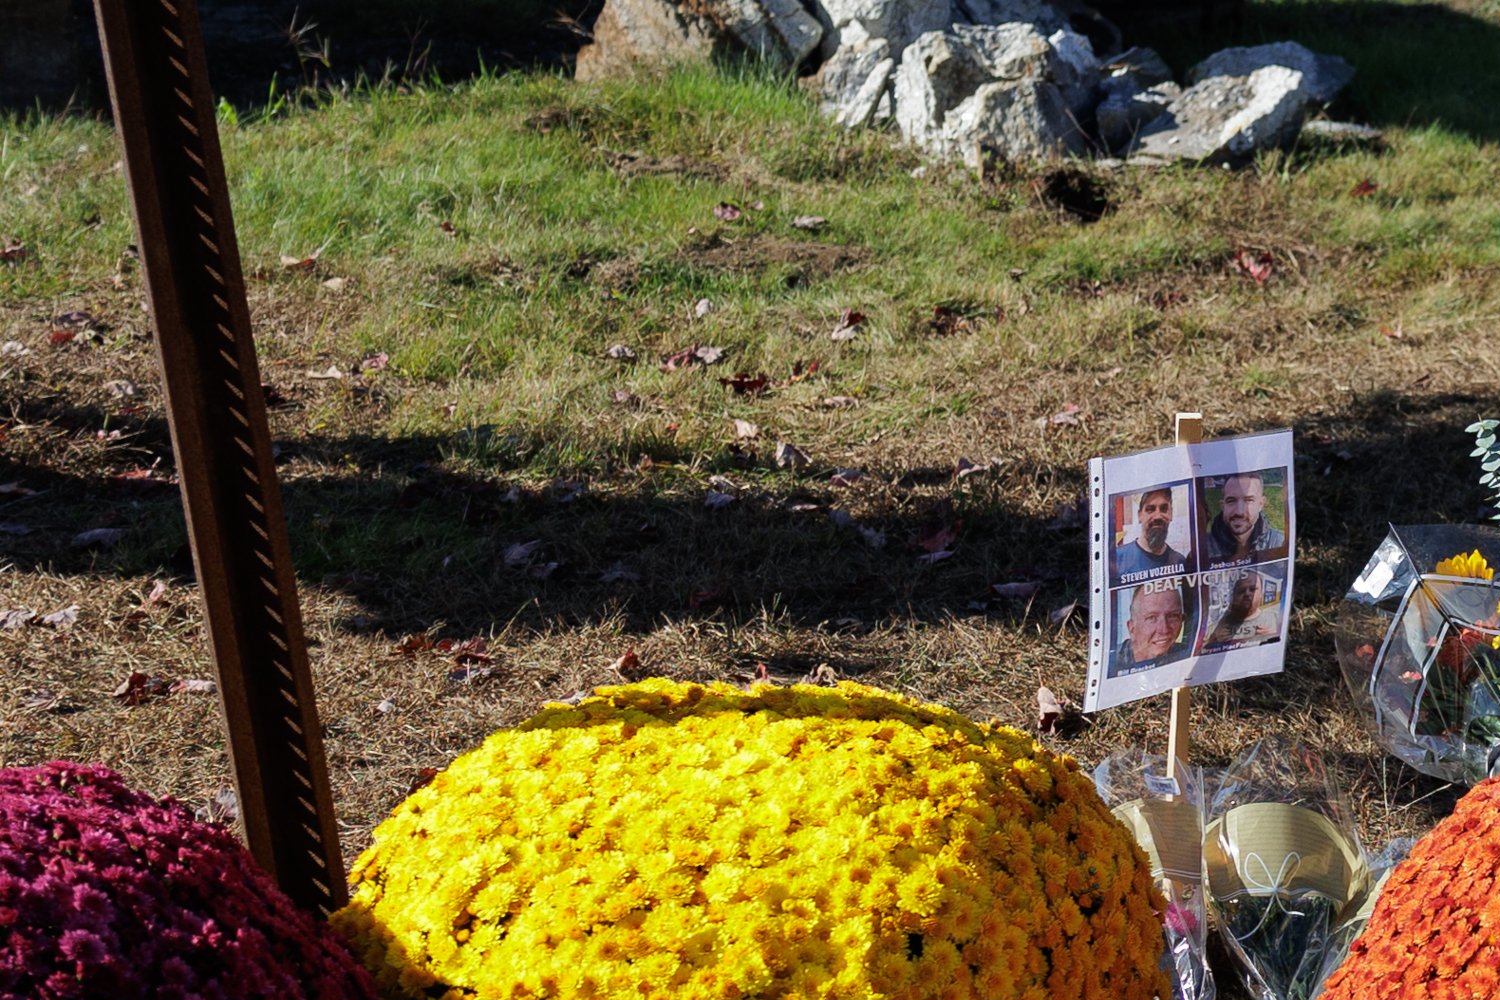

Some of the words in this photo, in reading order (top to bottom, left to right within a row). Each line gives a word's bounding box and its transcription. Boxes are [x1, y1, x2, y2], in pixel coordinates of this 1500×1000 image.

[1121, 569, 1149, 584] STEVEN
[1149, 563, 1185, 578] VOZZELLA
[1143, 576, 1183, 596] DEAF
[1185, 567, 1249, 588] VICTIMS
